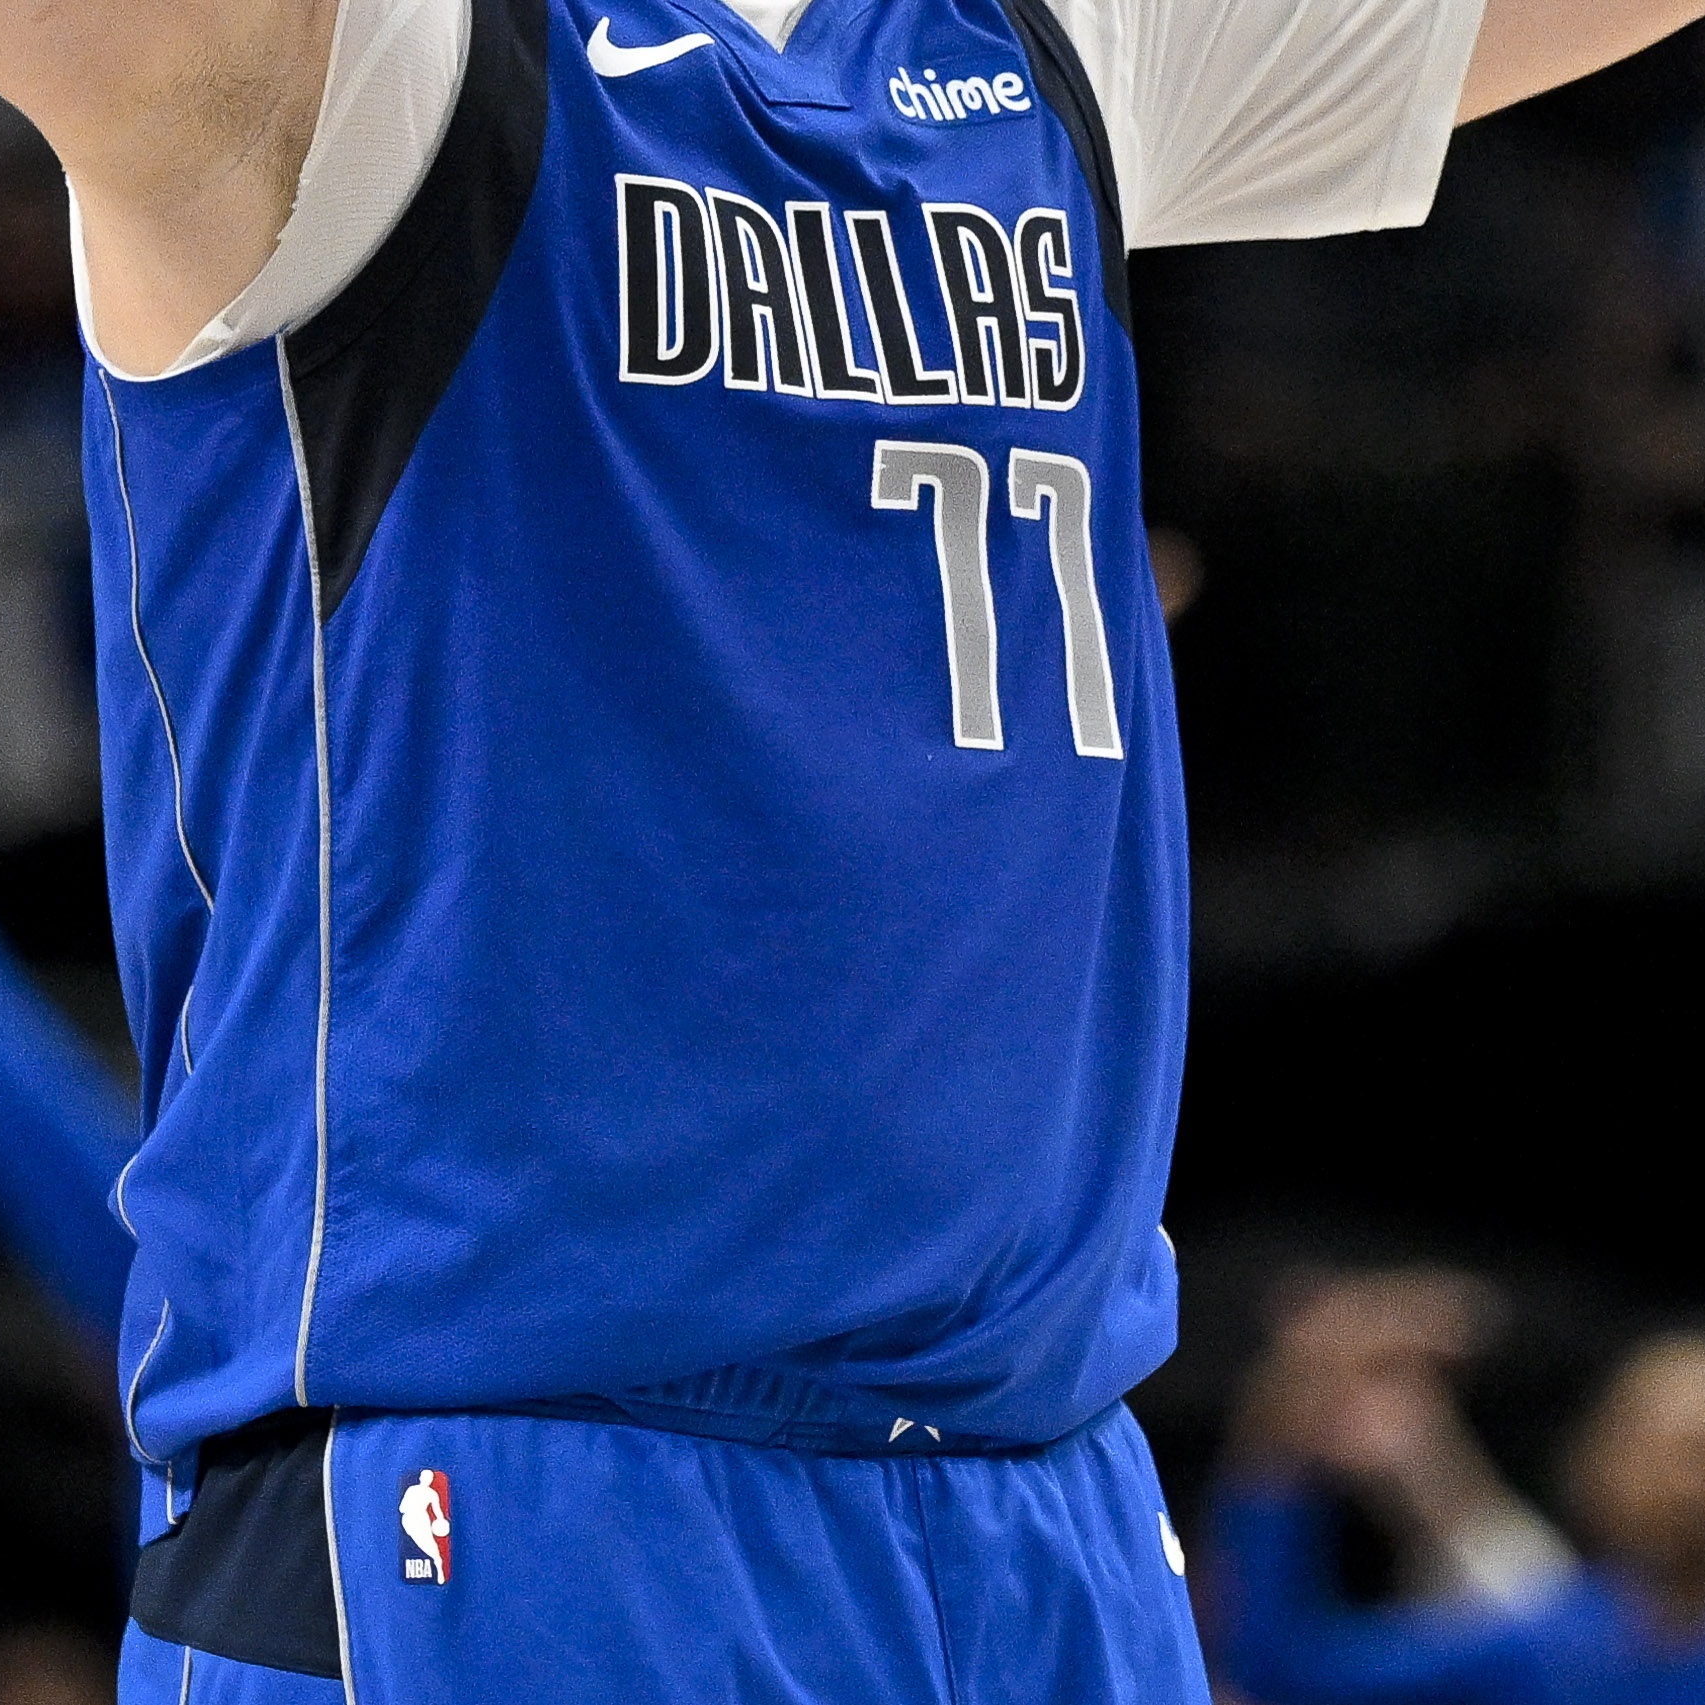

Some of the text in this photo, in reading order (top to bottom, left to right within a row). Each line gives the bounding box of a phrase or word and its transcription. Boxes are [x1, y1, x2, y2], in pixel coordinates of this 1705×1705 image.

[888, 66, 1032, 121] chime
[614, 173, 1085, 412] DALLAS
[871, 440, 1124, 761] 77
[405, 1558, 433, 1579] NBA
